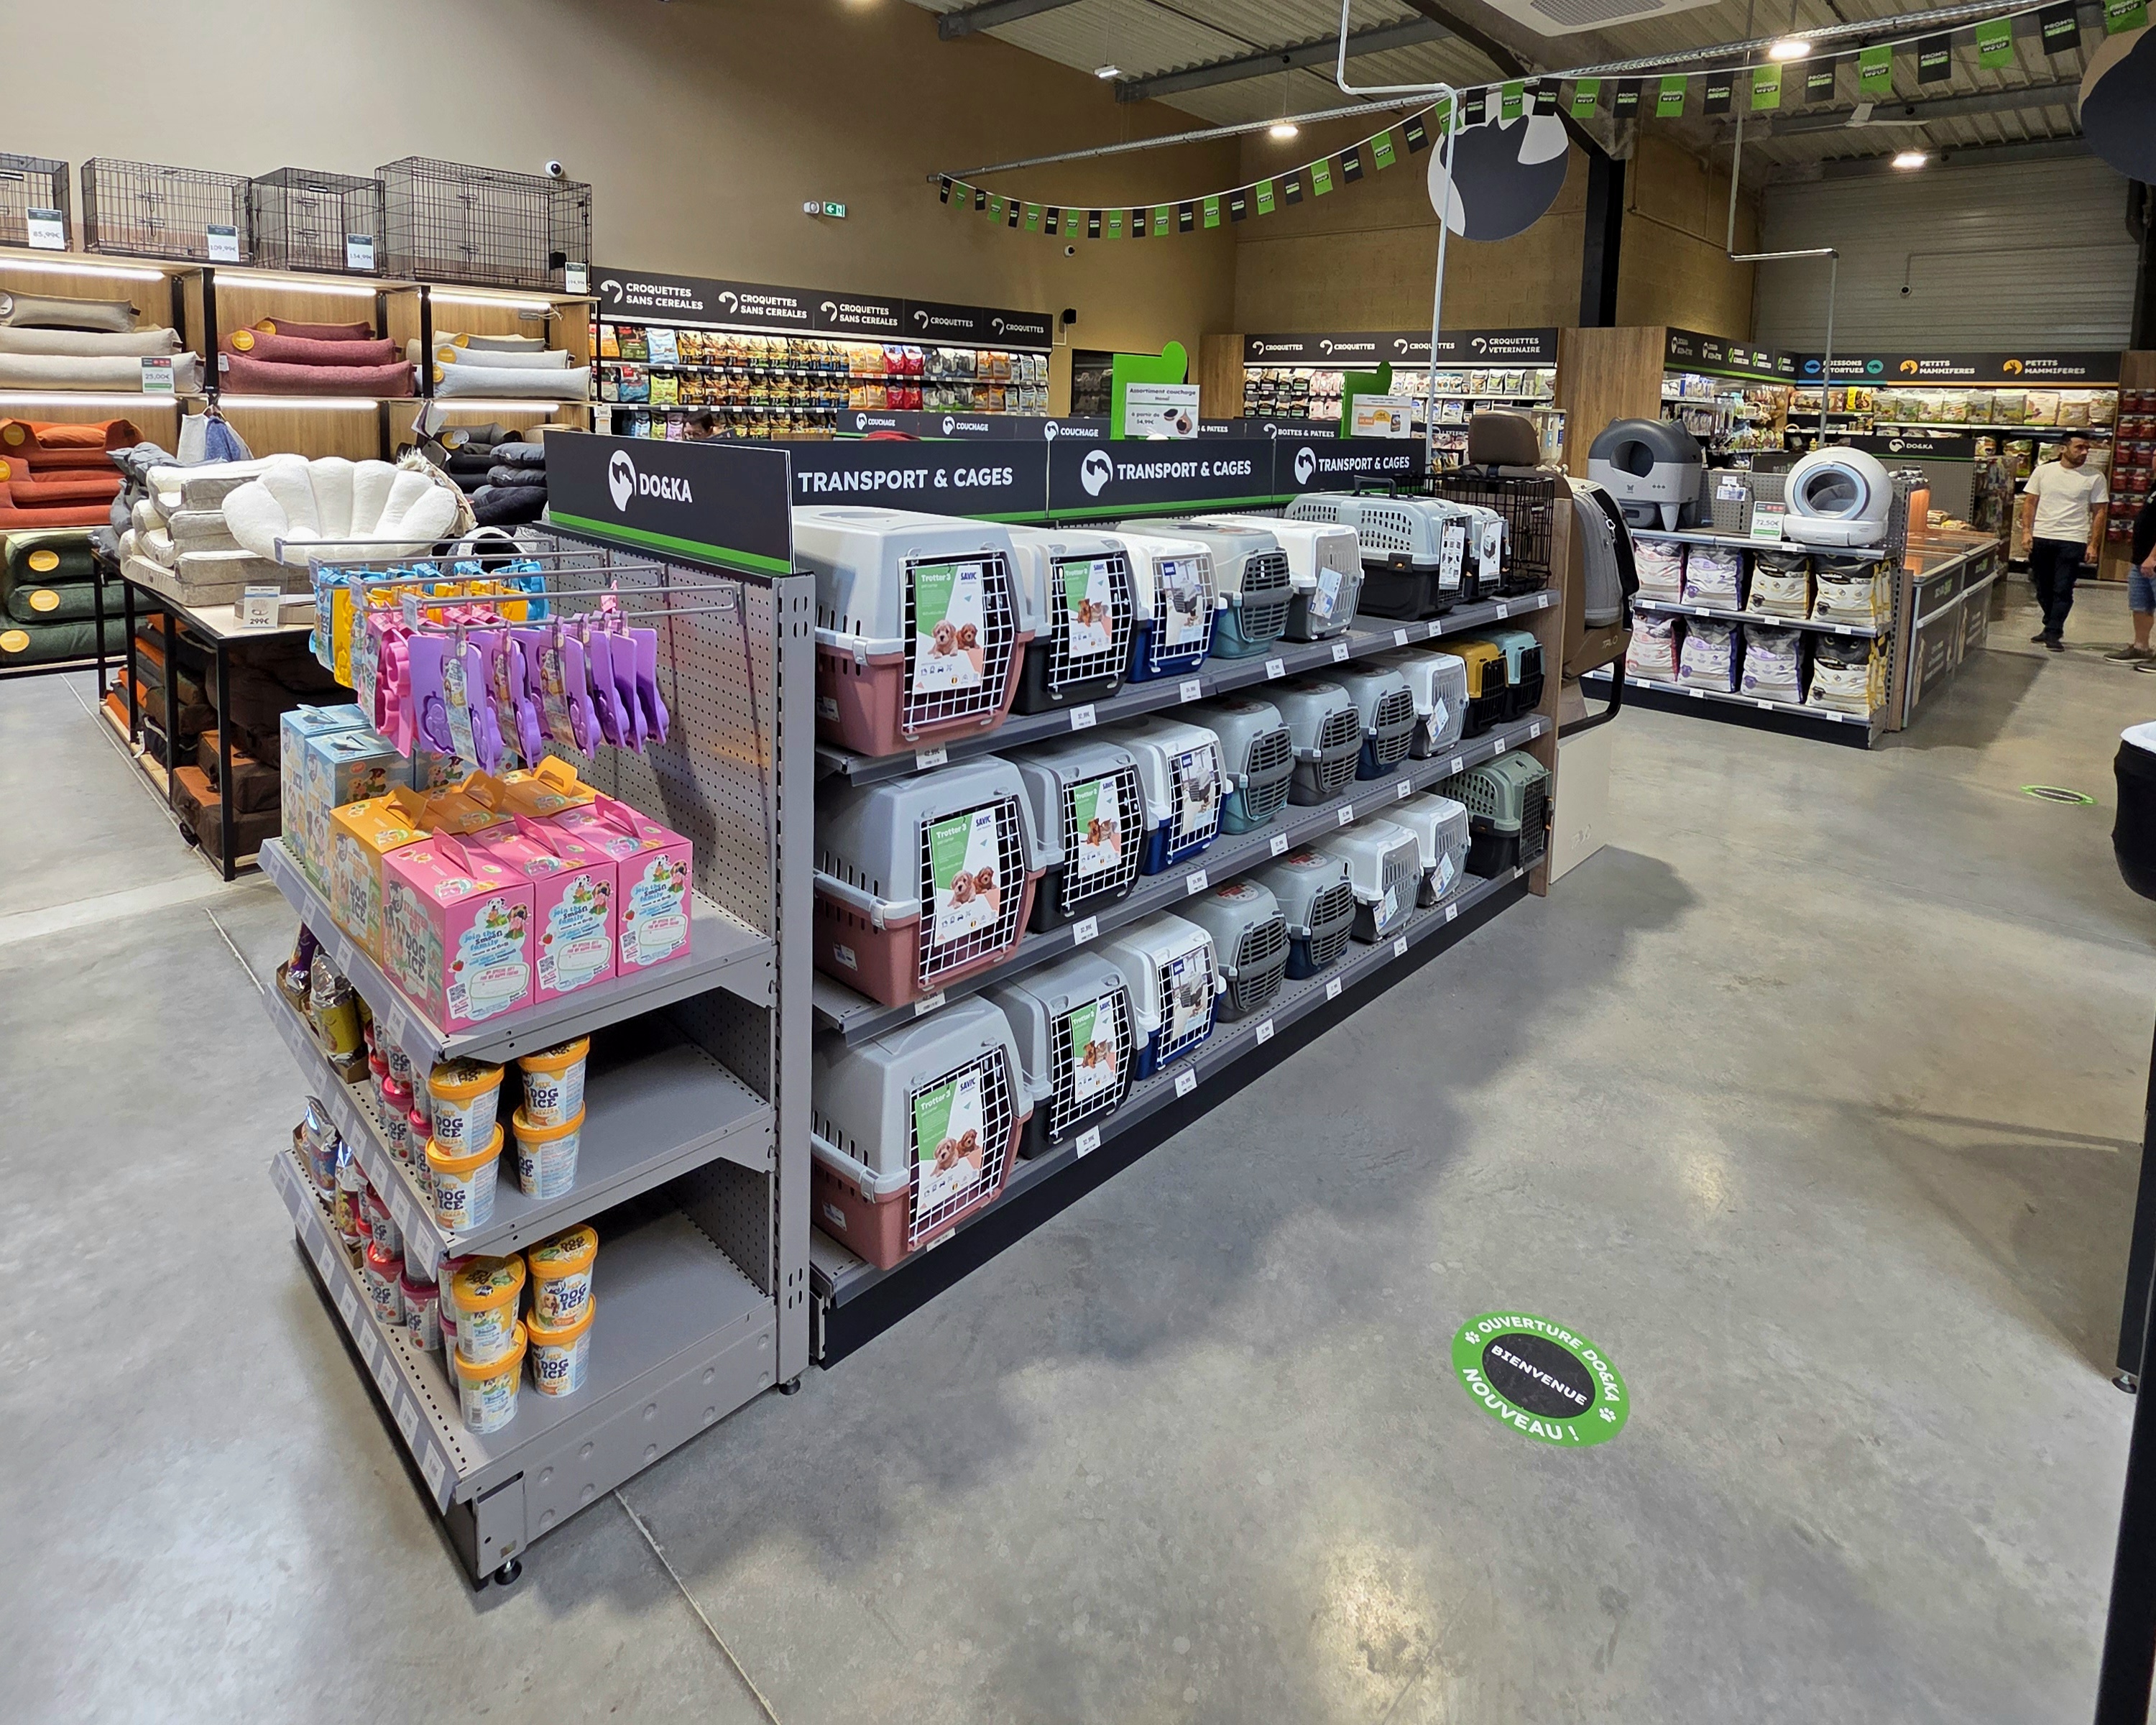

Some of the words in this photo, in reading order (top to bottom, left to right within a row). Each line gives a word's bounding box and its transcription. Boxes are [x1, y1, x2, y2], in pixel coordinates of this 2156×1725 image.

[626, 282, 691, 297] CROQUETTES
[626, 295, 653, 306] SANS
[655, 297, 704, 310] CEREALES
[740, 293, 797, 307] CROQUETTES
[740, 305, 763, 316] SANS
[765, 307, 807, 318] CEREALES
[839, 303, 889, 316] CROQUETTES
[839, 314, 860, 323] SANS
[862, 316, 898, 326] CEREALES
[930, 316, 973, 327] CROQUETTES
[1005, 323, 1044, 334] CROQUETTES
[867, 418, 895, 426] COUCHAGE
[956, 422, 989, 431] COUCHAGE
[1060, 427, 1099, 437] COUCHAGE
[1117, 461, 1197, 481] TRANSPORT
[1200, 461, 1210, 477] &
[1212, 460, 1251, 477] CAGES
[1318, 457, 1373, 473] TRANSPORT
[1373, 457, 1381, 470] &
[1383, 456, 1410, 469] CAGES
[798, 469, 929, 493] TRANSPORT
[934, 469, 948, 488] &
[954, 467, 1013, 487] CAGES
[639, 473, 693, 503] DO&KA
[960, 571, 977, 581] SAVIC
[1102, 781, 1114, 789] SAVIC
[1076, 790, 1093, 799] Trotter
[975, 815, 991, 827] SAVIC
[936, 826, 961, 840] Trotter
[960, 823, 967, 832] 3
[349, 878, 367, 909] DOG
[351, 899, 366, 925] ICE
[553, 908, 568, 917] join
[558, 914, 584, 925] family
[464, 932, 481, 944] join
[405, 930, 426, 965] DOG
[470, 939, 499, 951] family
[407, 955, 425, 982] ICE
[1073, 1013, 1090, 1025] Trotter
[959, 1077, 976, 1092] SAVIC
[530, 1087, 558, 1098] DOG
[533, 1098, 557, 1108] ICE
[920, 1093, 946, 1110] Trotter
[945, 1090, 952, 1098] 3
[436, 1117, 464, 1128] DOG
[437, 1128, 461, 1138] ICE
[519, 1159, 534, 1169] OG
[437, 1190, 466, 1200] DOG
[439, 1201, 464, 1210] ICE
[561, 1236, 585, 1250] DOG
[559, 1283, 587, 1303] DOG
[561, 1297, 585, 1311] ICE
[540, 1358, 568, 1370] DOG
[1478, 1316, 1583, 1350] OUVERTURE
[1582, 1349, 1620, 1402] DO&KA
[543, 1369, 567, 1379] ICE
[1491, 1345, 1588, 1406] BIENVENUE
[1462, 1368, 1563, 1440] NOUVEAU
[1567, 1425, 1580, 1442] !
